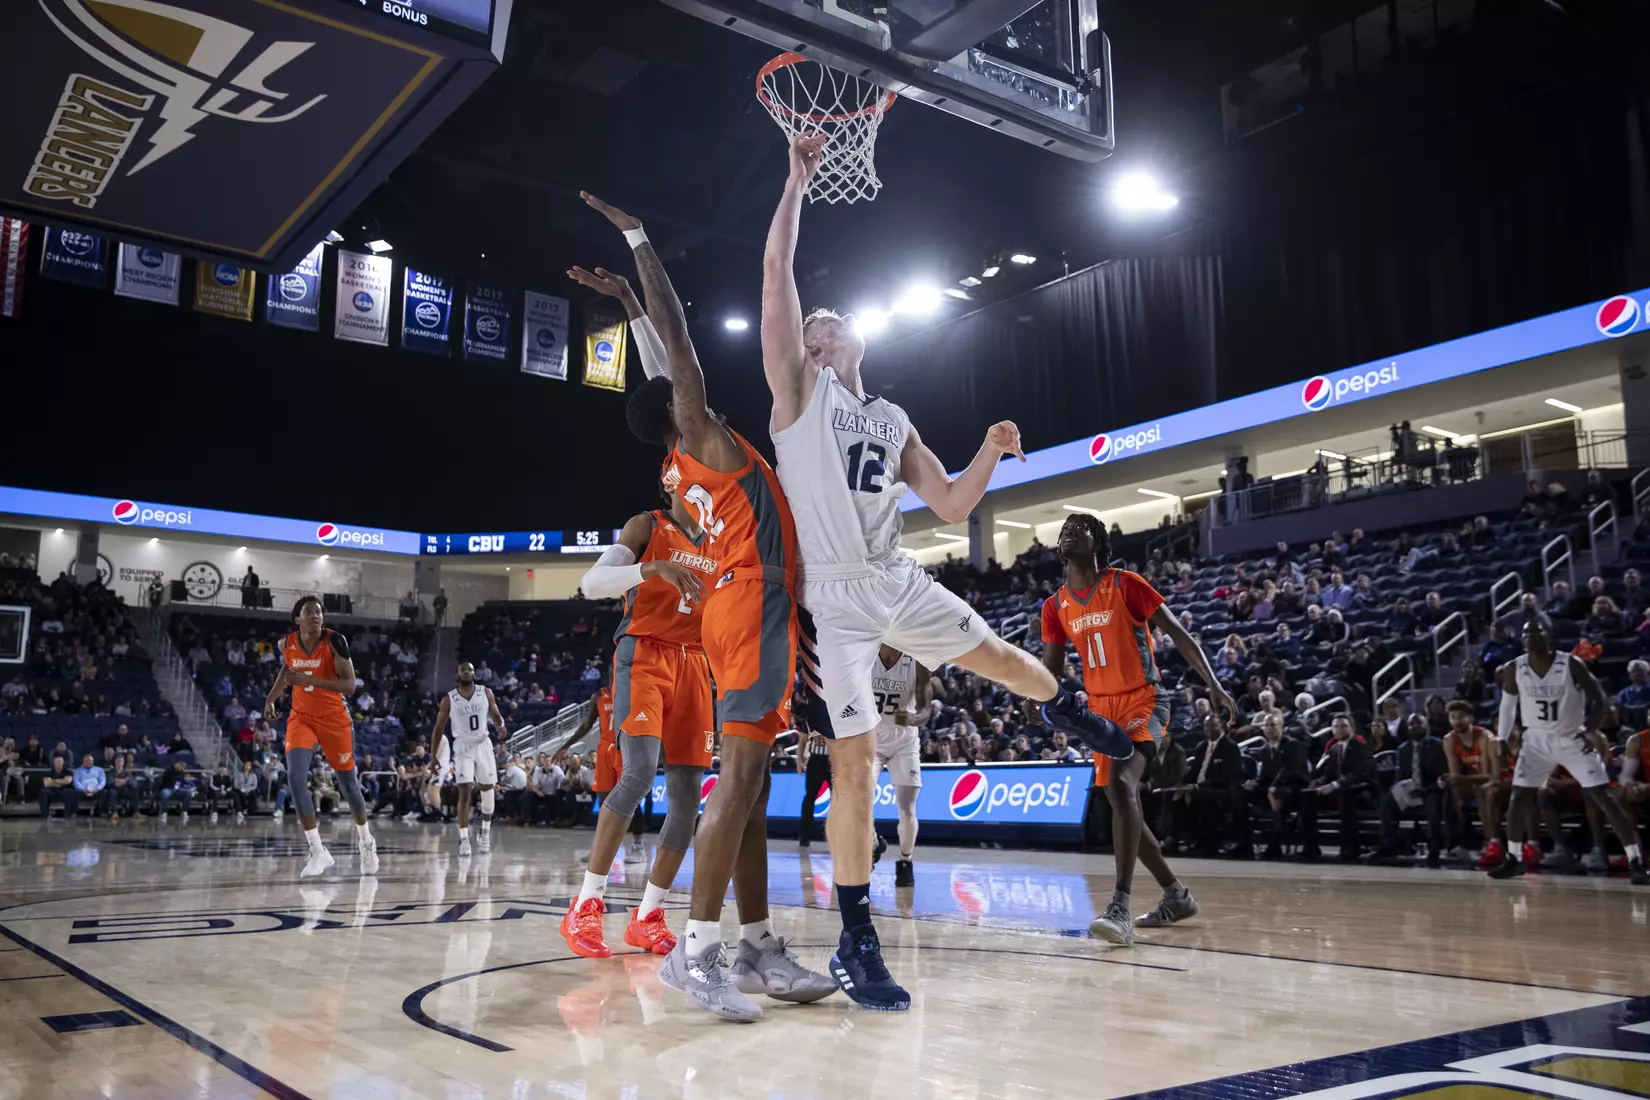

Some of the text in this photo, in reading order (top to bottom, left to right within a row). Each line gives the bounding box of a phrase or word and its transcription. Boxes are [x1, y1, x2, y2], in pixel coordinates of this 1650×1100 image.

[382, 1, 428, 26] BONUS
[22, 73, 156, 209] LANCERS
[46, 252, 104, 271] CHAMPIONS
[123, 275, 174, 290] CHAMPIONS
[415, 272, 444, 287] 2017
[410, 282, 447, 296] WOMEN'S
[476, 286, 503, 300] 2017
[267, 300, 317, 315] CHAMPIONS
[534, 300, 560, 312] 2017
[345, 313, 376, 325] DIVISION
[404, 327, 449, 341] CHAMPIONS
[1335, 361, 1399, 400] pepsi
[833, 408, 900, 448] LANCERS
[1114, 424, 1161, 456] pepsi
[847, 441, 886, 493] 12
[141, 508, 192, 525] pepsi
[341, 531, 384, 546] pepsi
[468, 535, 505, 552] CBU
[529, 533, 545, 551] 22
[576, 531, 599, 545] 5:25
[670, 549, 718, 574] UTRGV
[120, 567, 164, 577] EQUIPPED
[134, 575, 156, 584] SERV
[1070, 610, 1112, 634] UTRGV
[1087, 632, 1107, 669] 11
[872, 677, 906, 692] ANCERS
[873, 692, 900, 715] 35
[1535, 699, 1558, 722] 31
[470, 714, 479, 731] 0
[873, 783, 897, 805] psi
[986, 775, 1071, 814] pepsi
